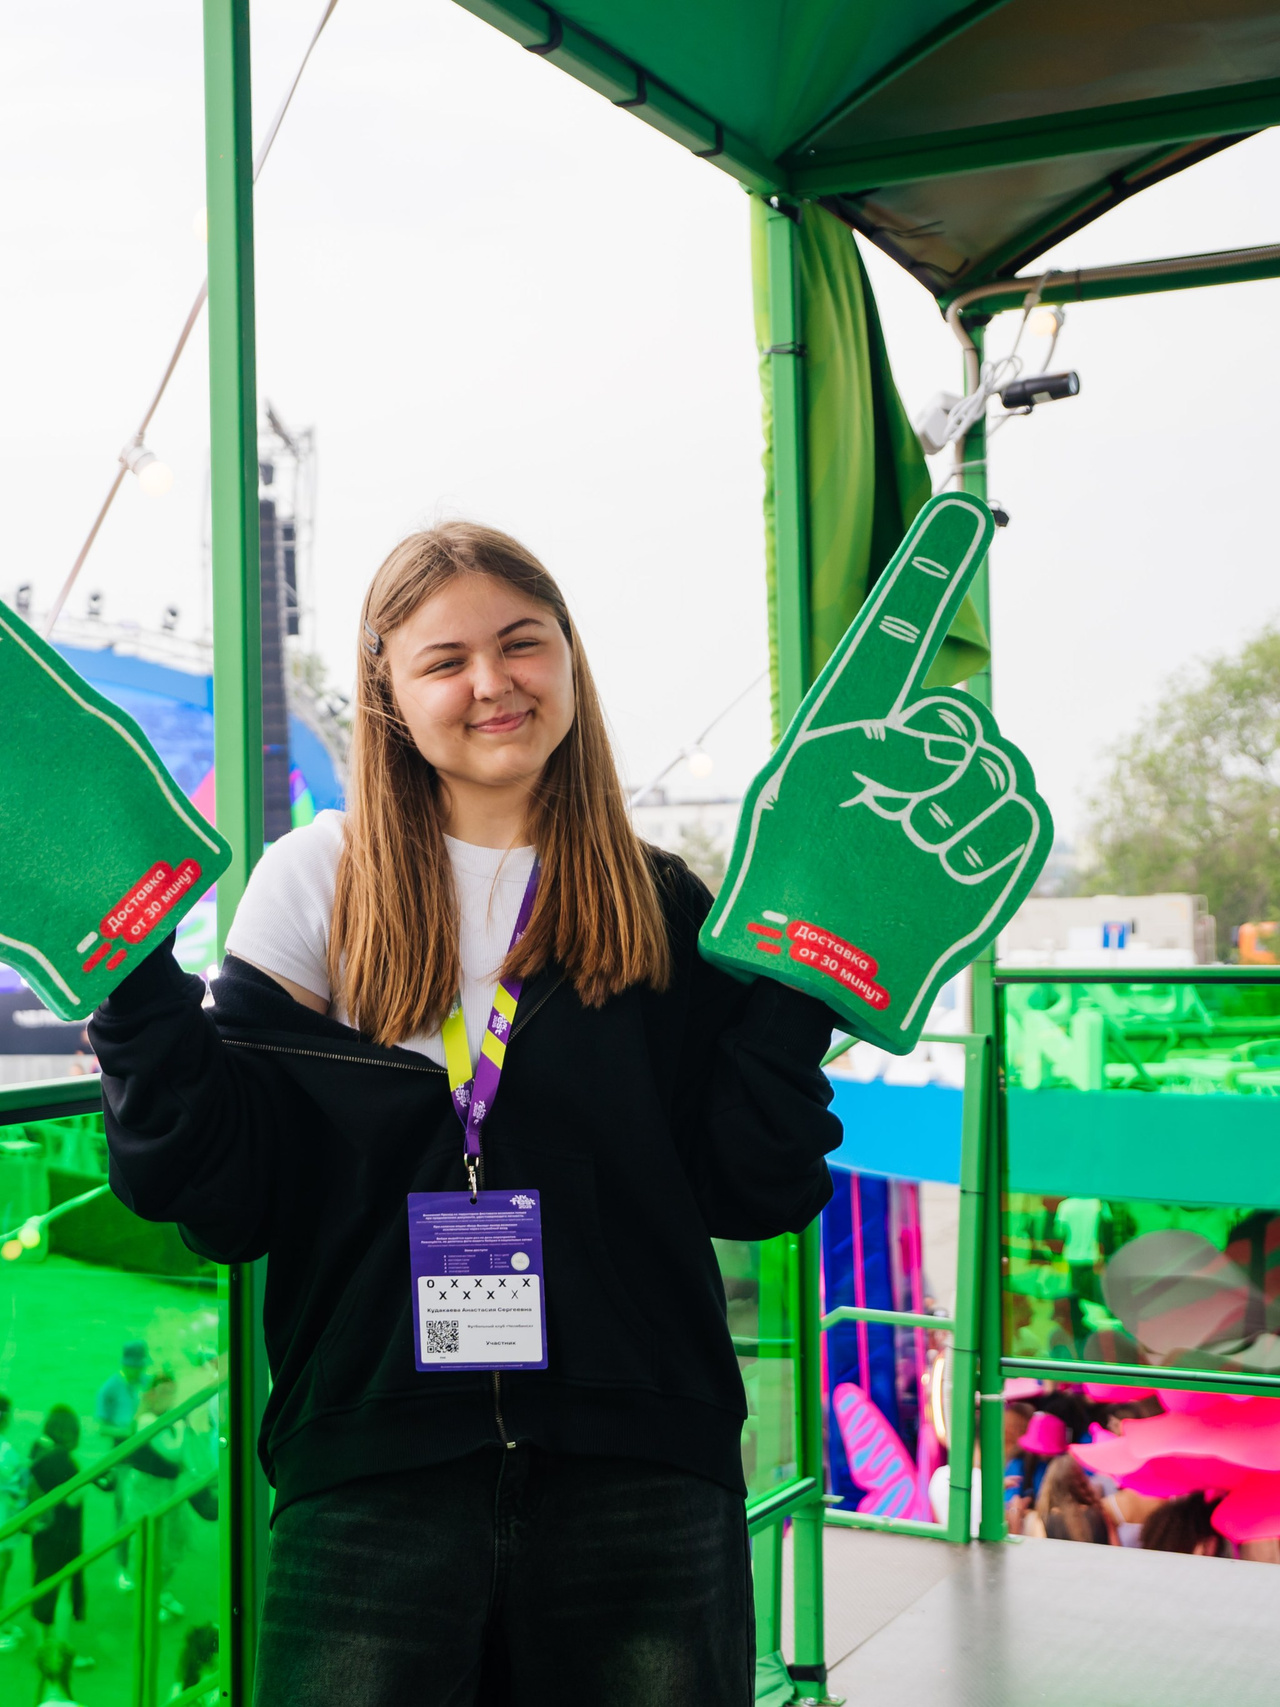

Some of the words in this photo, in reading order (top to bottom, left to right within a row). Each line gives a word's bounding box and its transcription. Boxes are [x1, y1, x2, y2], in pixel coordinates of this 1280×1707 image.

[107, 869, 166, 932] Доставка
[131, 918, 147, 936] от
[144, 901, 162, 919] 30
[161, 865, 195, 903] минут
[794, 925, 869, 971] Доставка
[799, 948, 819, 960] от
[820, 955, 839, 971] 30
[840, 968, 884, 1002] минут
